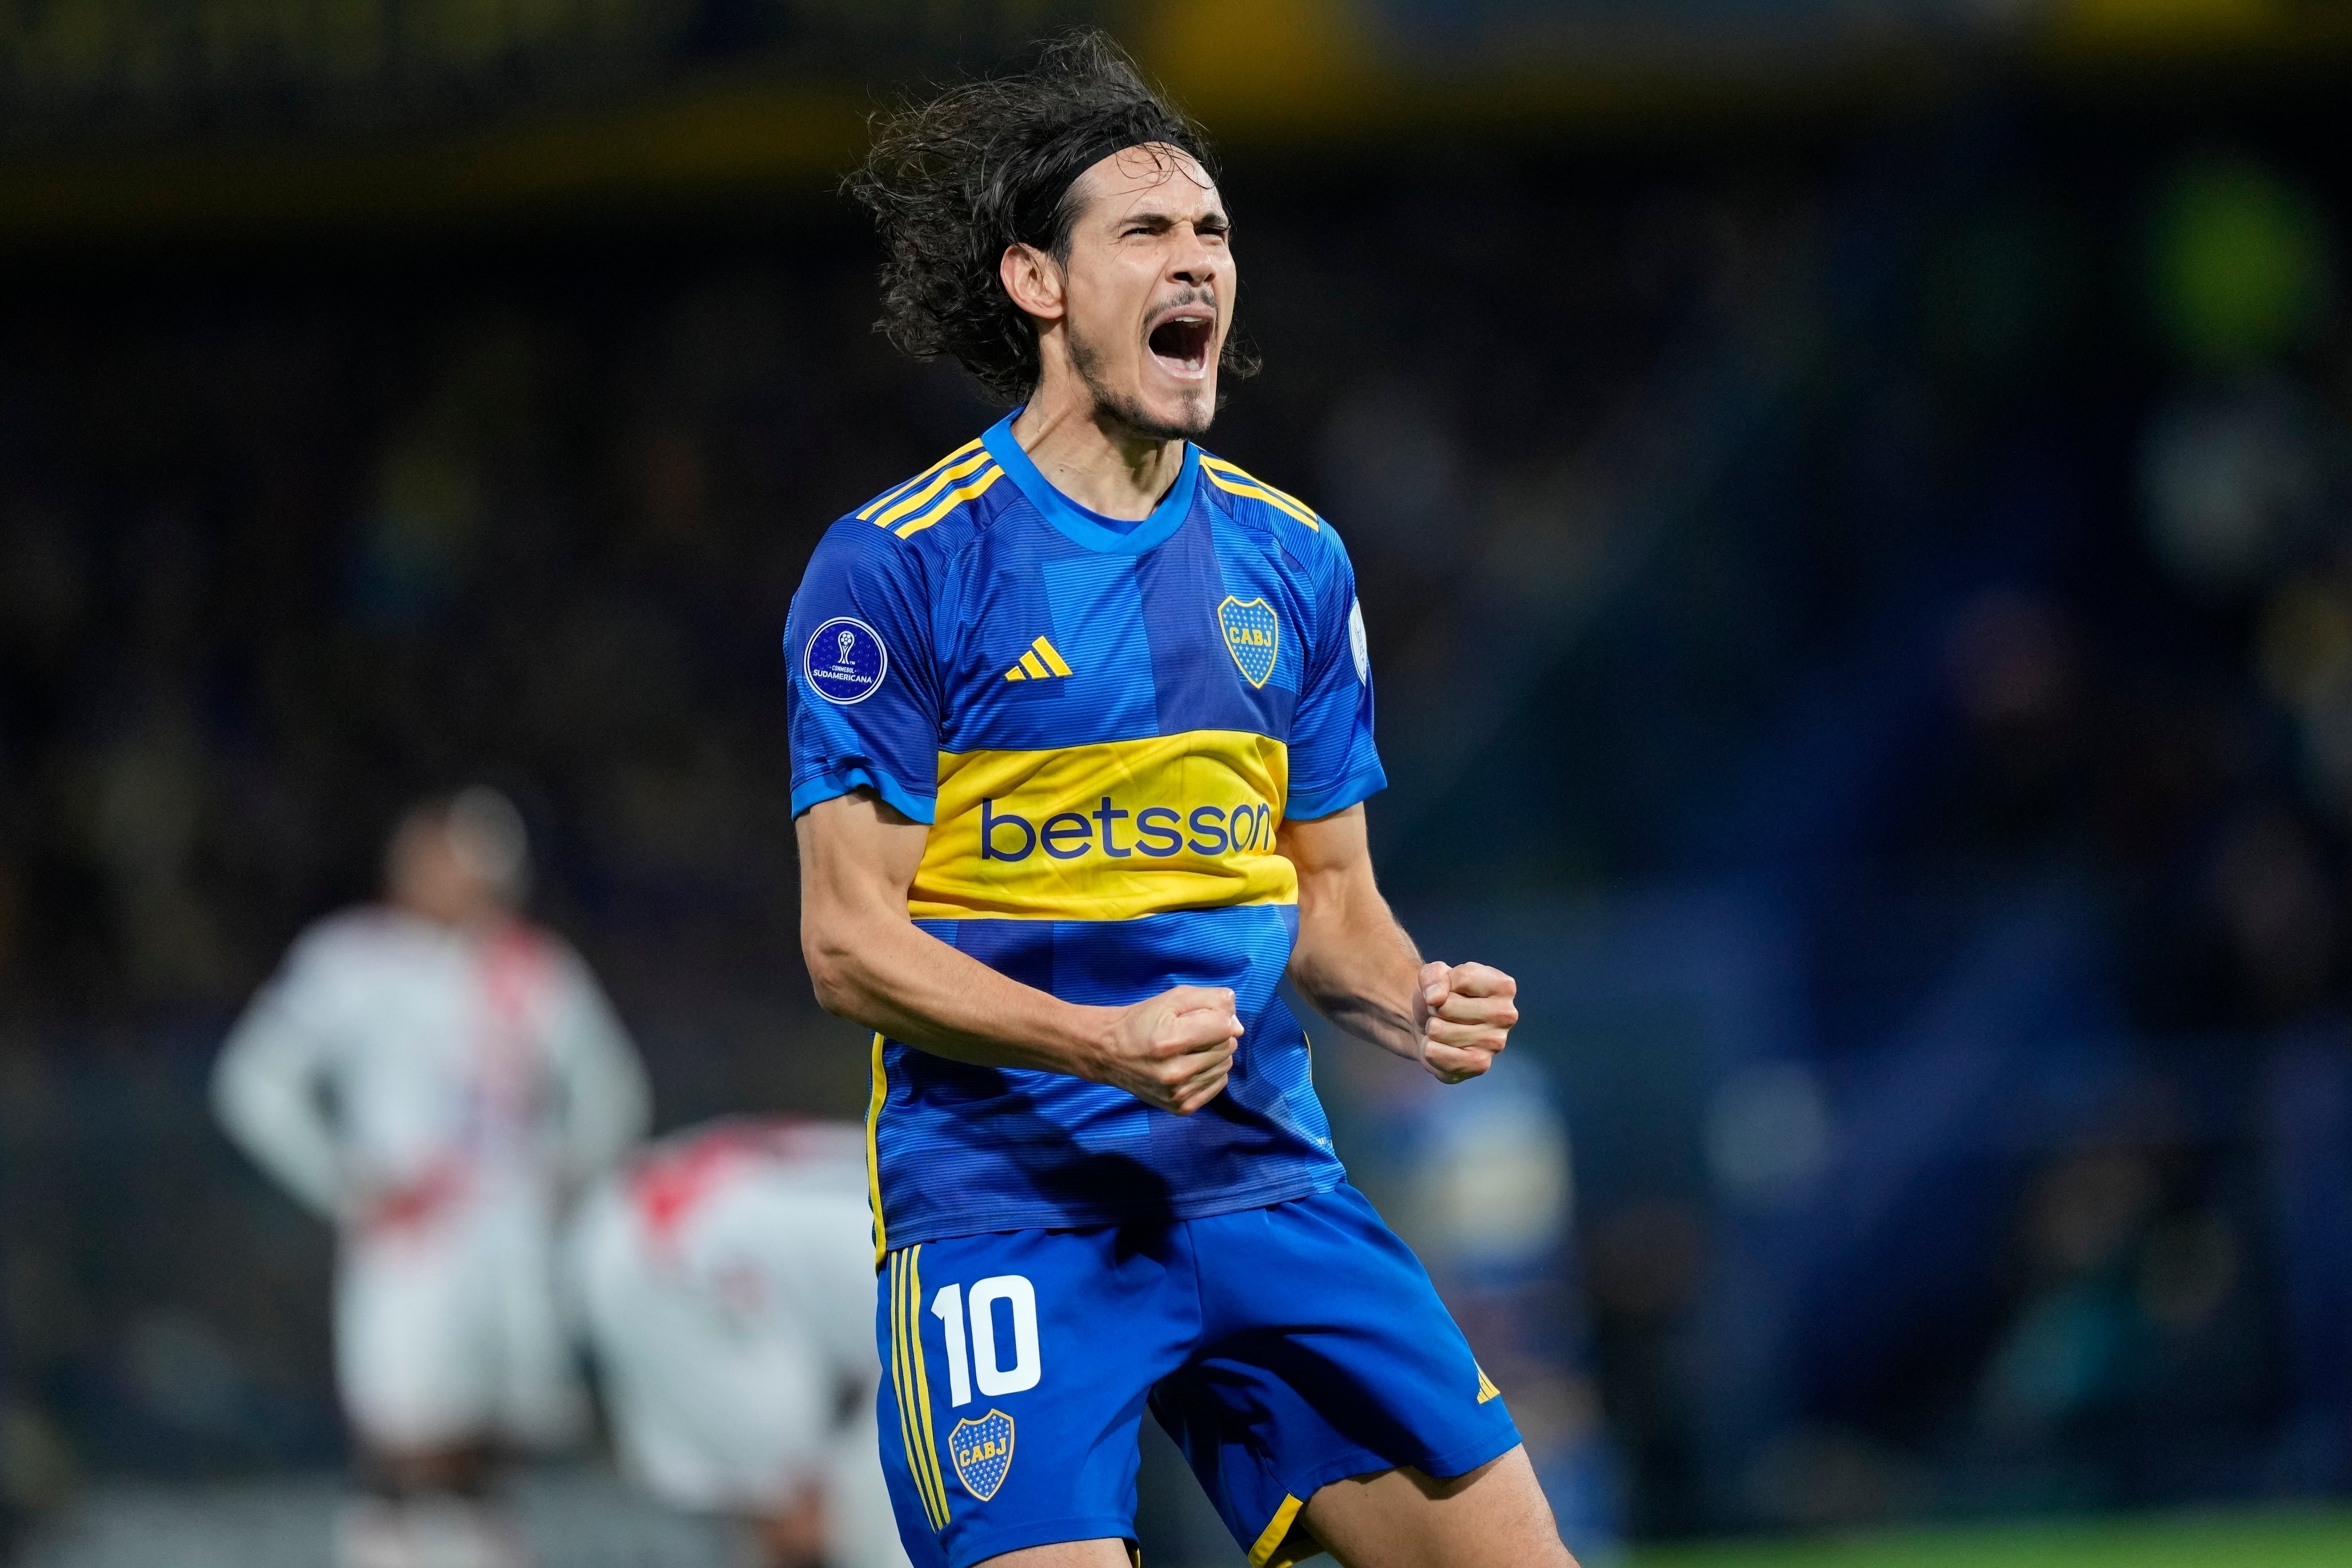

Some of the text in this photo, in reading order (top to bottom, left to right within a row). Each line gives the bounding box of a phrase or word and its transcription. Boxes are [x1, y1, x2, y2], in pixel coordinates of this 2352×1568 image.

[1229, 626, 1272, 647] CABJ
[813, 669, 872, 683] SUDAMERICANA
[982, 797, 1270, 862] betsson
[931, 1275, 1041, 1408] 10
[960, 1437, 1006, 1467] CABJ
